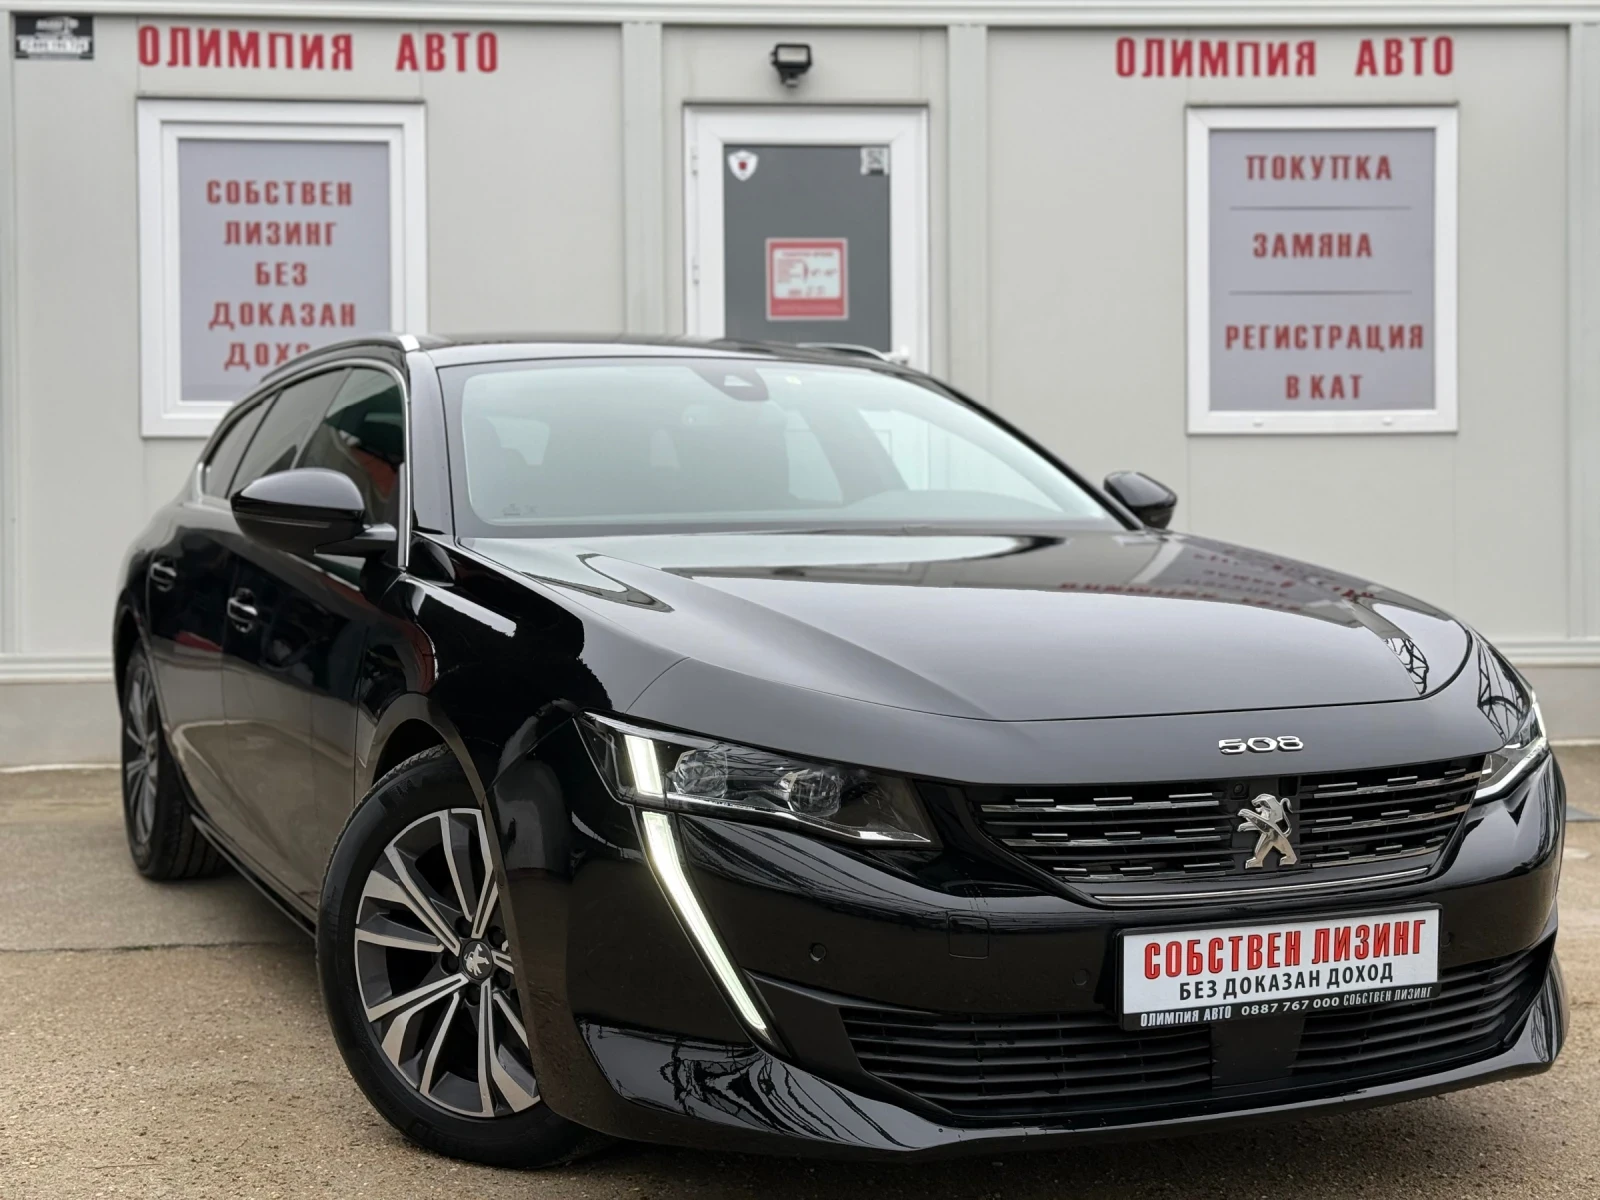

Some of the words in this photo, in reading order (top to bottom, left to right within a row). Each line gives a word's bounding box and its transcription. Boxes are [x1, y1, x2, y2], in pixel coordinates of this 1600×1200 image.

[138, 25, 355, 72] ОЛИМПИЯ
[396, 31, 499, 73] АВТО
[1115, 37, 1318, 78] ОЛИМПИЯ
[1354, 36, 1455, 77] АВТО
[1245, 154, 1393, 181] ПОКУПКА
[206, 179, 353, 207] СОБСТВЕН
[224, 221, 338, 247] ЛИЗИНГ
[1252, 232, 1373, 259] ЗАМЯНА
[255, 262, 308, 287] БЕЗ
[208, 302, 357, 330] ДОКАЗАН
[1225, 324, 1425, 352] РЕГИСТРАЦИЯ
[224, 342, 311, 372] ДОХ
[1285, 374, 1301, 400] В
[1310, 374, 1364, 400] КАТ
[1218, 735, 1304, 755] 508
[1144, 930, 1301, 980] СОБСТВЕН
[1311, 919, 1427, 965] ЛИЗИНГ
[1179, 979, 1218, 1001] БЕЗ
[1222, 969, 1321, 1000] ДОКАЗАН
[1326, 962, 1394, 990] ДОХОД
[1140, 1009, 1200, 1027] ОЛИМПИЯ
[1203, 1005, 1232, 1021] АВТО
[1241, 1002, 1279, 1016] 0887
[1282, 1000, 1310, 1012] 767
[1313, 997, 1340, 1009] 000
[1343, 990, 1392, 1006] СОБСТВЕН
[1394, 986, 1433, 1002] ЛИЗИНГ
